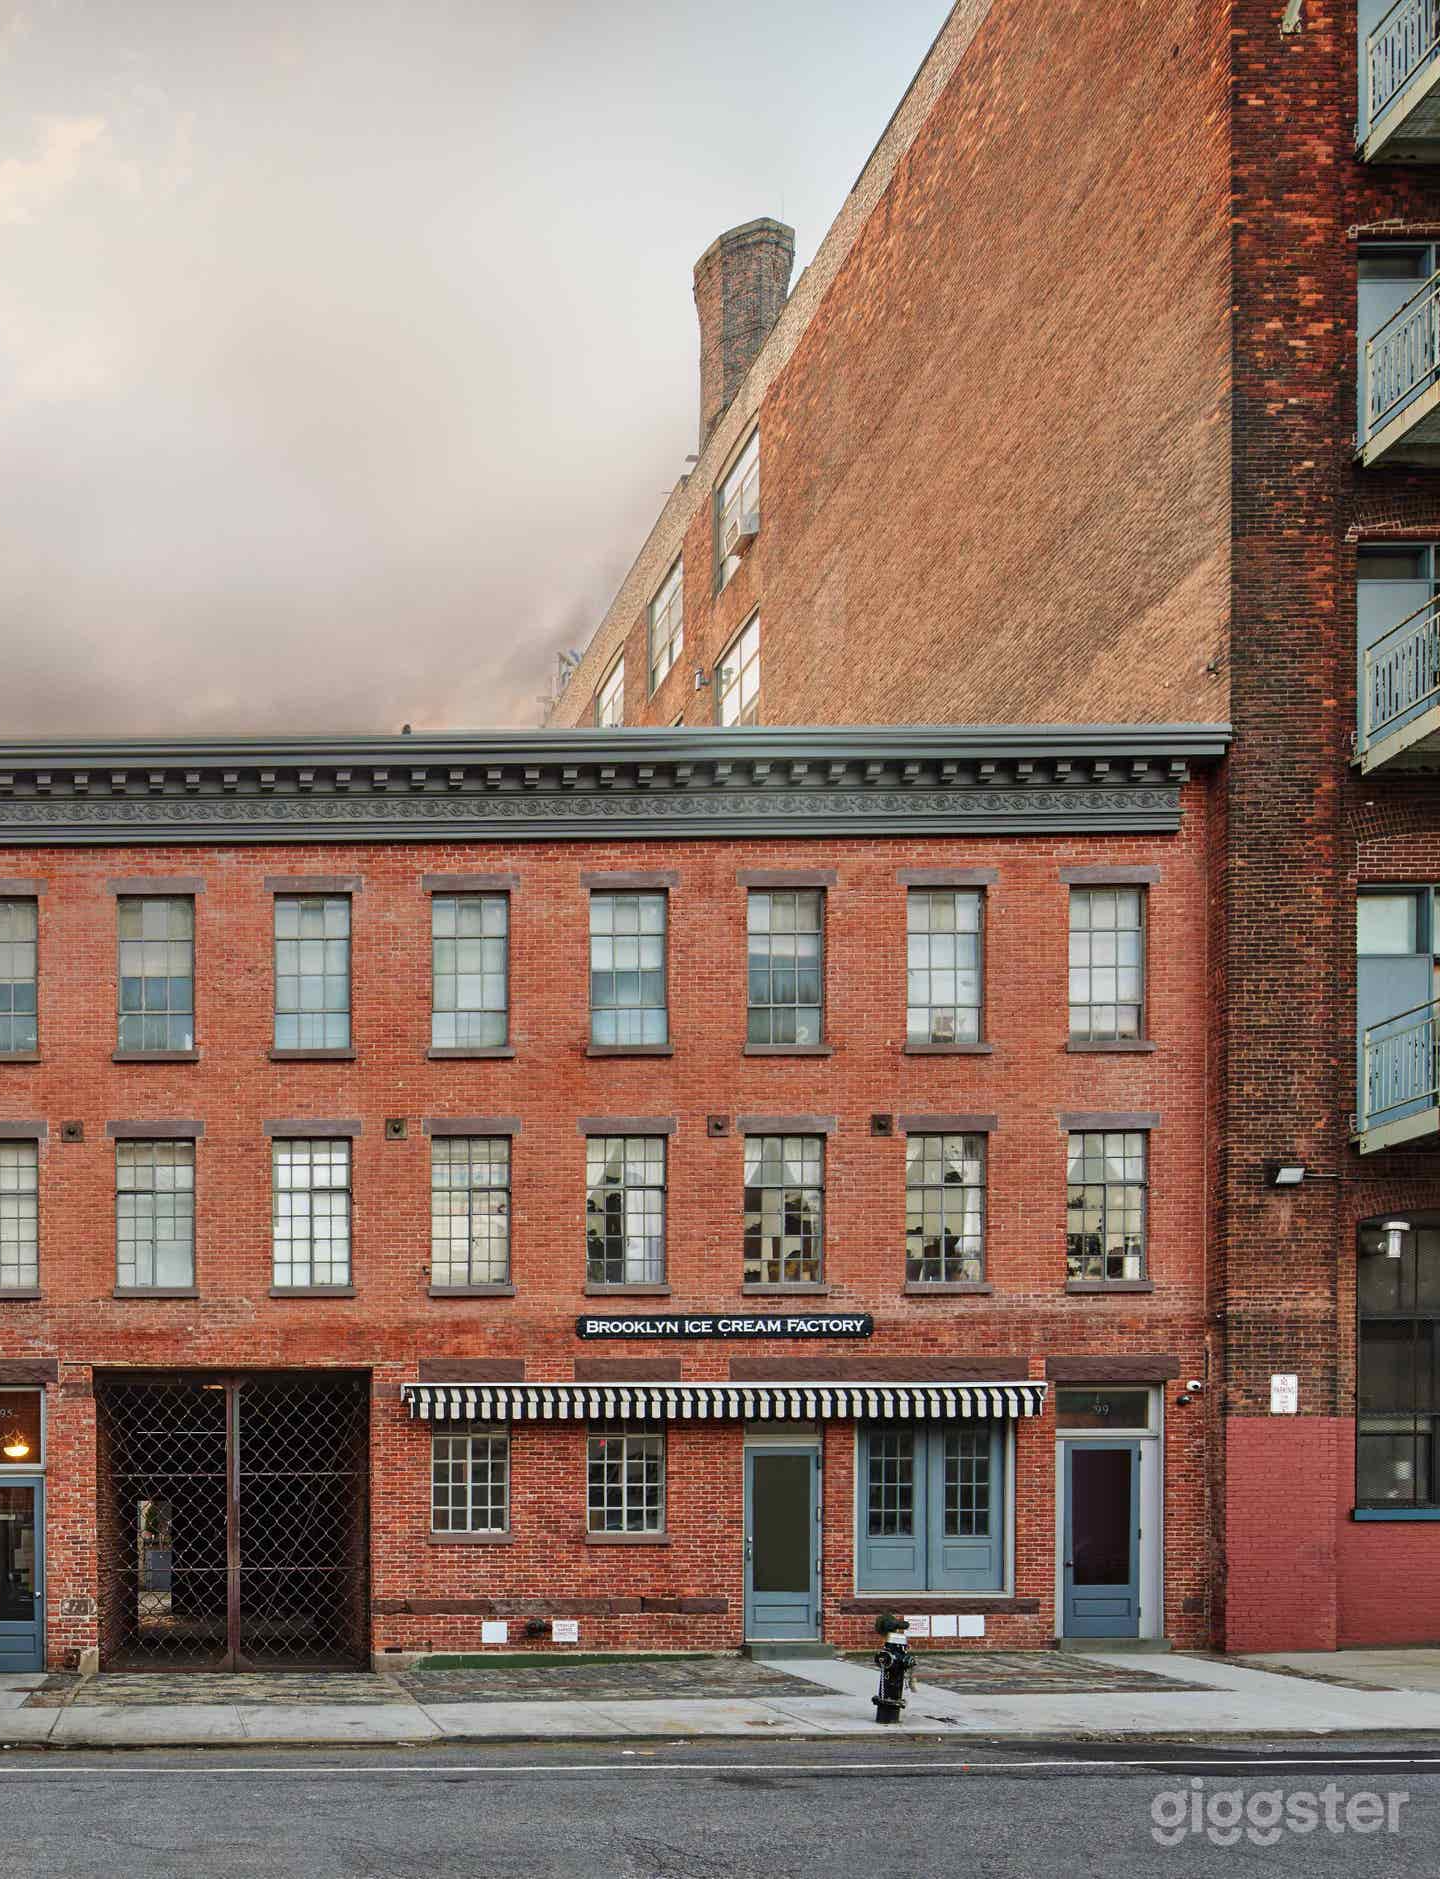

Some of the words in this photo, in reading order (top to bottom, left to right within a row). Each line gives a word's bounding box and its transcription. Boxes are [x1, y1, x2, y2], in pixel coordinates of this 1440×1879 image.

[586, 1320, 678, 1333] BROOKLYN
[684, 1320, 713, 1333] ICE
[717, 1319, 782, 1332] CREAM
[786, 1318, 865, 1332] FACTORY
